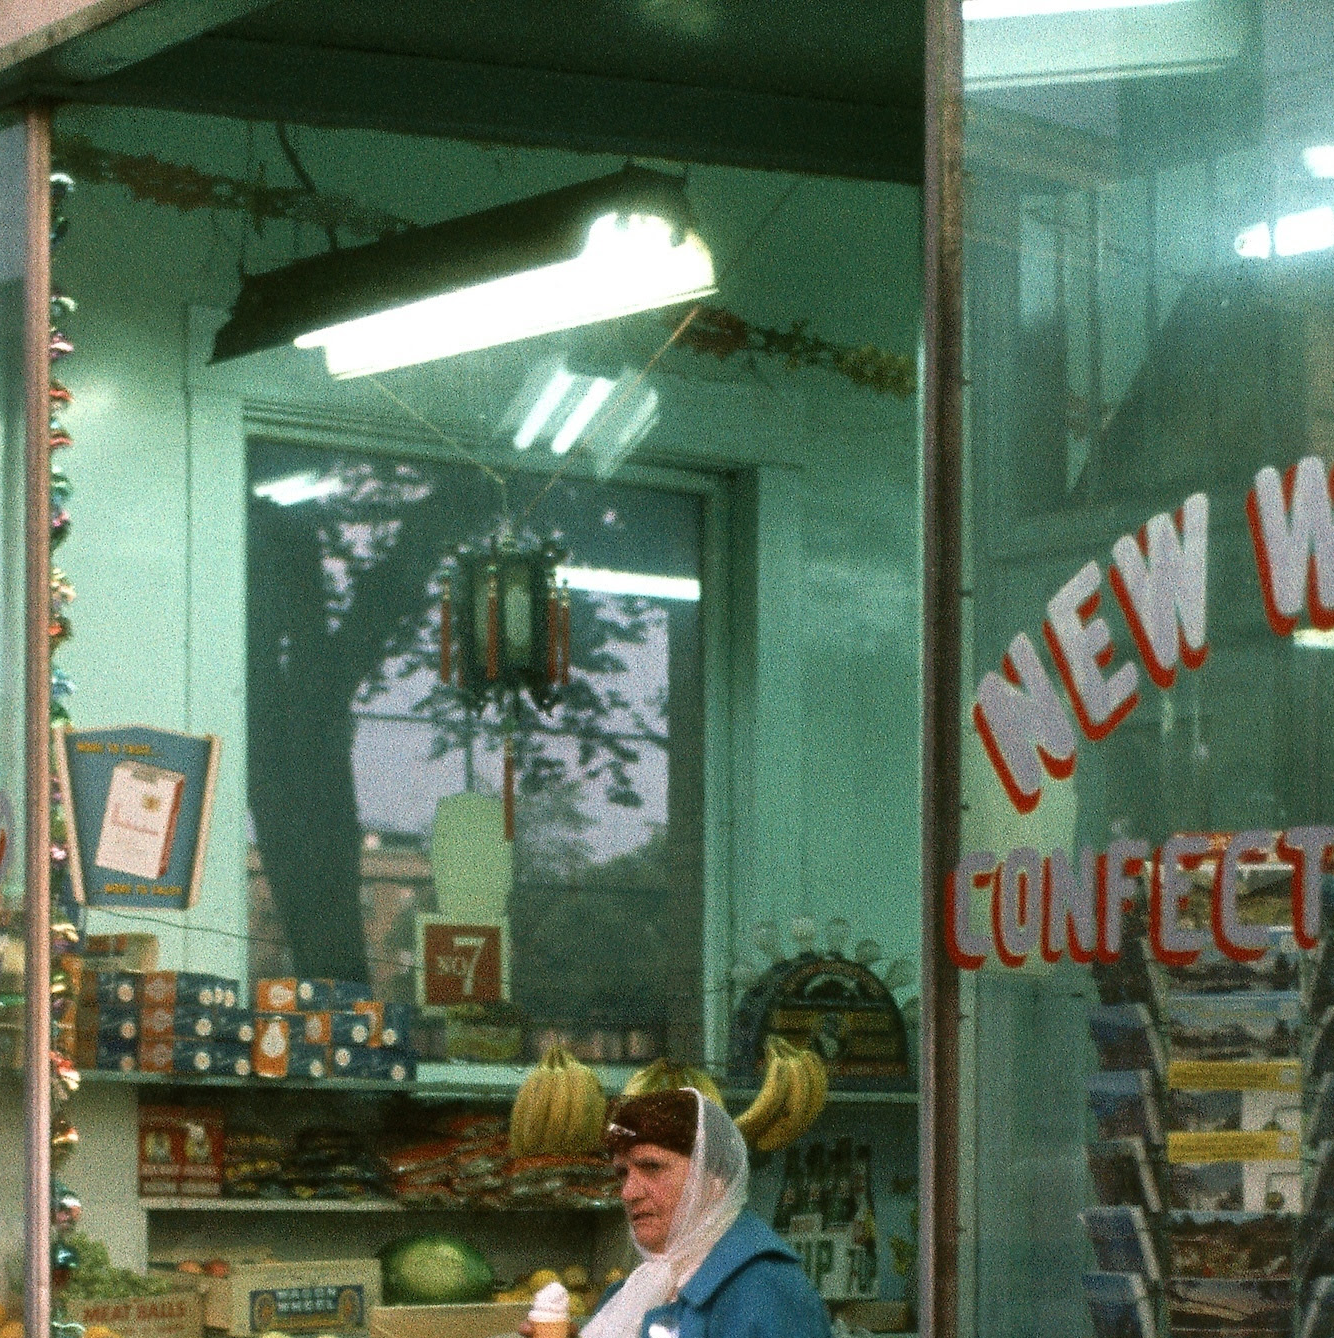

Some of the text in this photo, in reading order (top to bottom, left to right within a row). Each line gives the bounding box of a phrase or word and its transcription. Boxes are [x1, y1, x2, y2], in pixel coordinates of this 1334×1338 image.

[972, 493, 1209, 814] NEW
[83, 1300, 187, 1322] MEAT BALLS
